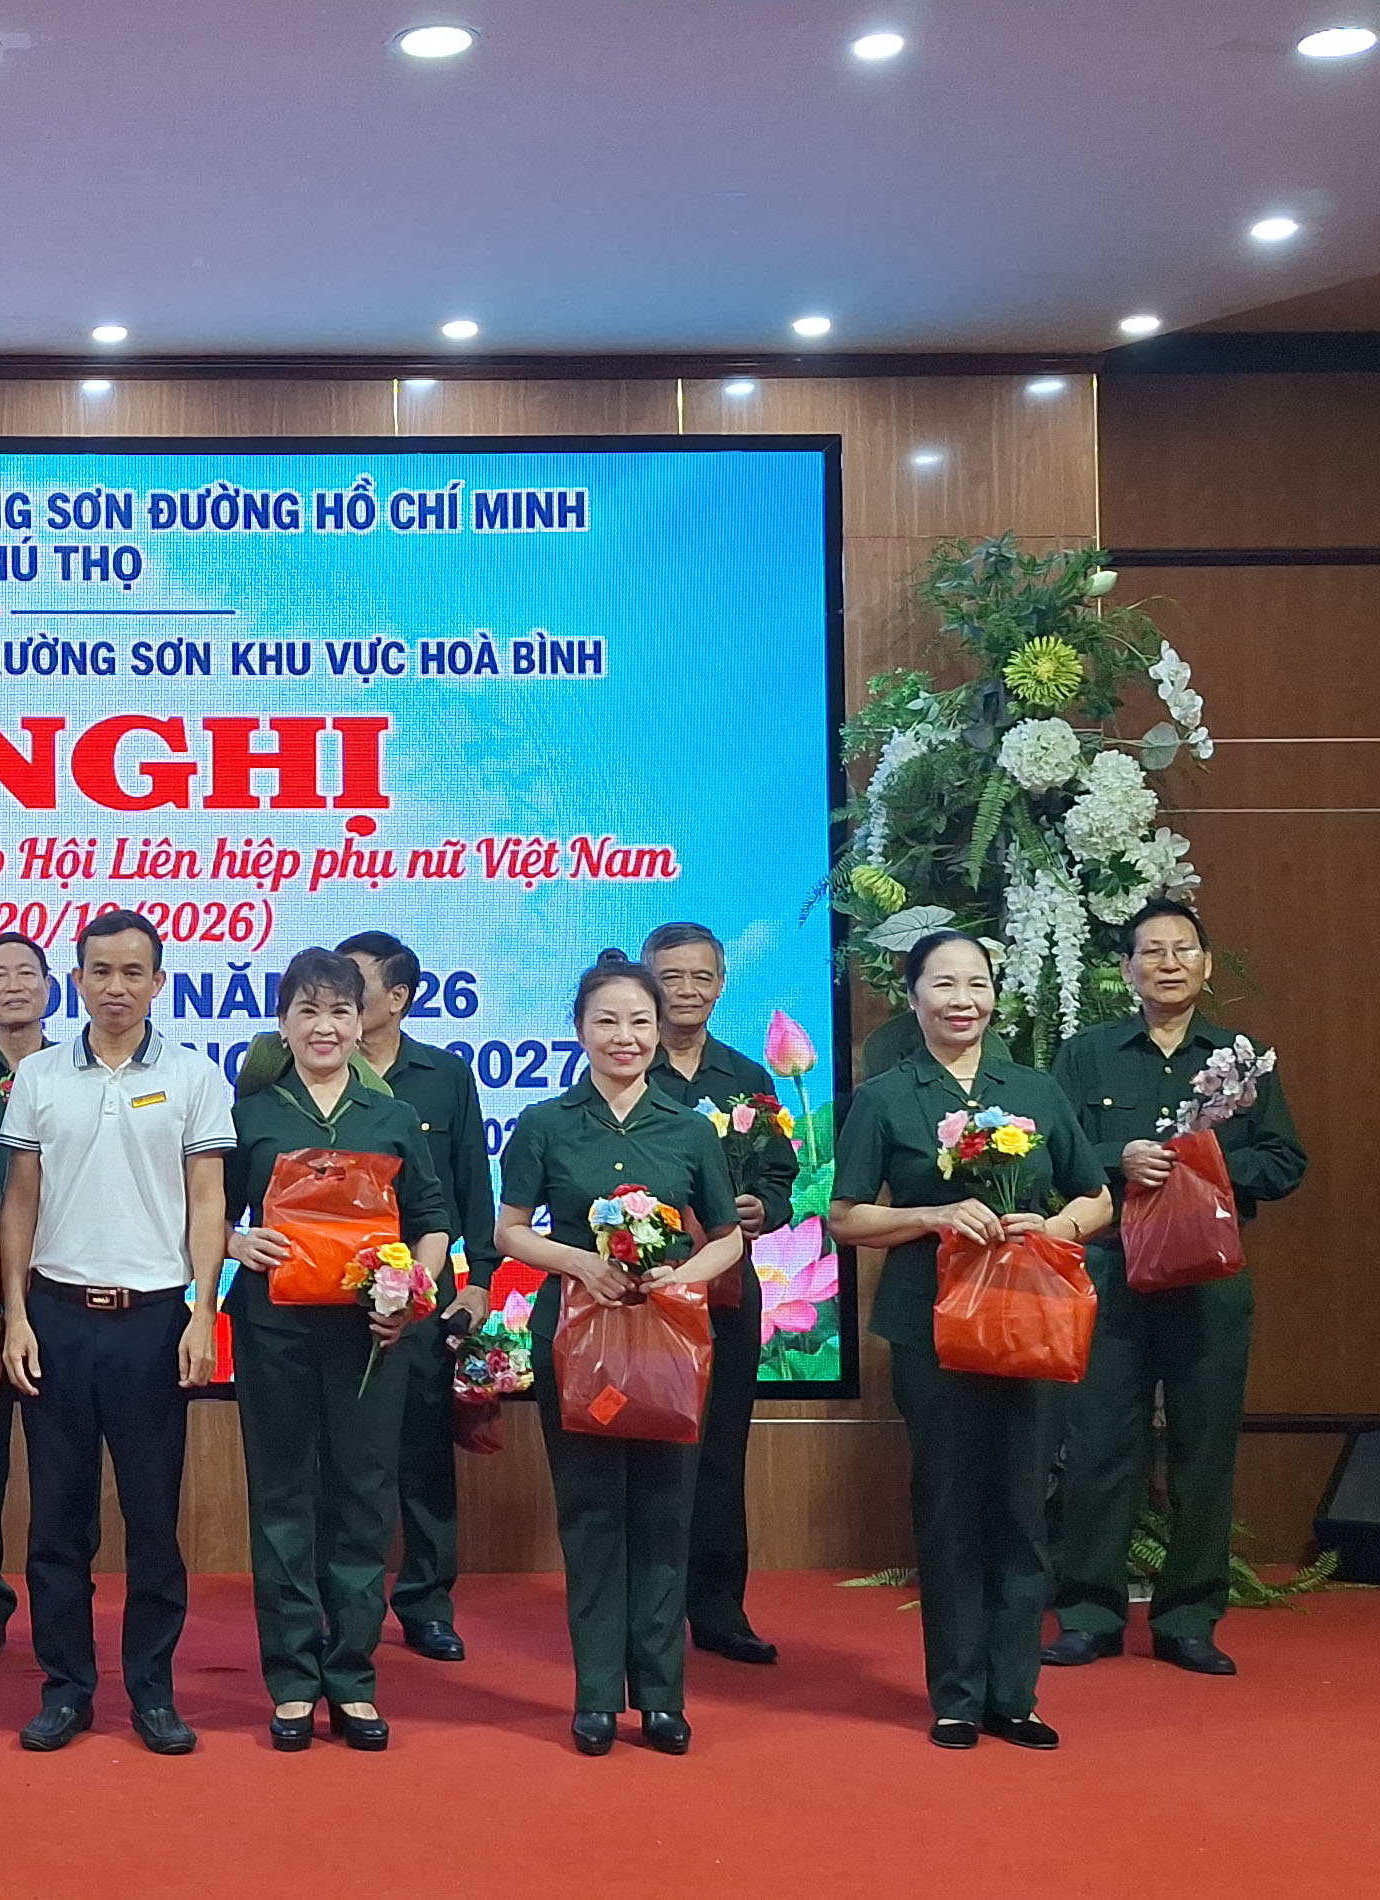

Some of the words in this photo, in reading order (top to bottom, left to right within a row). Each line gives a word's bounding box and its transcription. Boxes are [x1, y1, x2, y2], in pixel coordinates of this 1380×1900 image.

[47, 487, 133, 531] SƠN
[147, 482, 300, 531] ĐƯỜNG
[316, 475, 376, 530] HỒ
[390, 482, 461, 531] CHÍ
[474, 491, 586, 530] MINH
[53, 545, 143, 591] THỌ
[130, 636, 212, 676] SƠN
[231, 641, 311, 676] KHU
[324, 636, 406, 684] VỰC
[421, 632, 500, 676] HOÀ
[513, 631, 602, 675] BÌNH
[20, 838, 97, 890] Hội
[110, 838, 201, 879] Liên
[212, 838, 301, 892] hiệp
[310, 838, 396, 892] phụ
[408, 840, 465, 879] nữ
[477, 838, 558, 889] Việt
[570, 838, 678, 879] Nam
